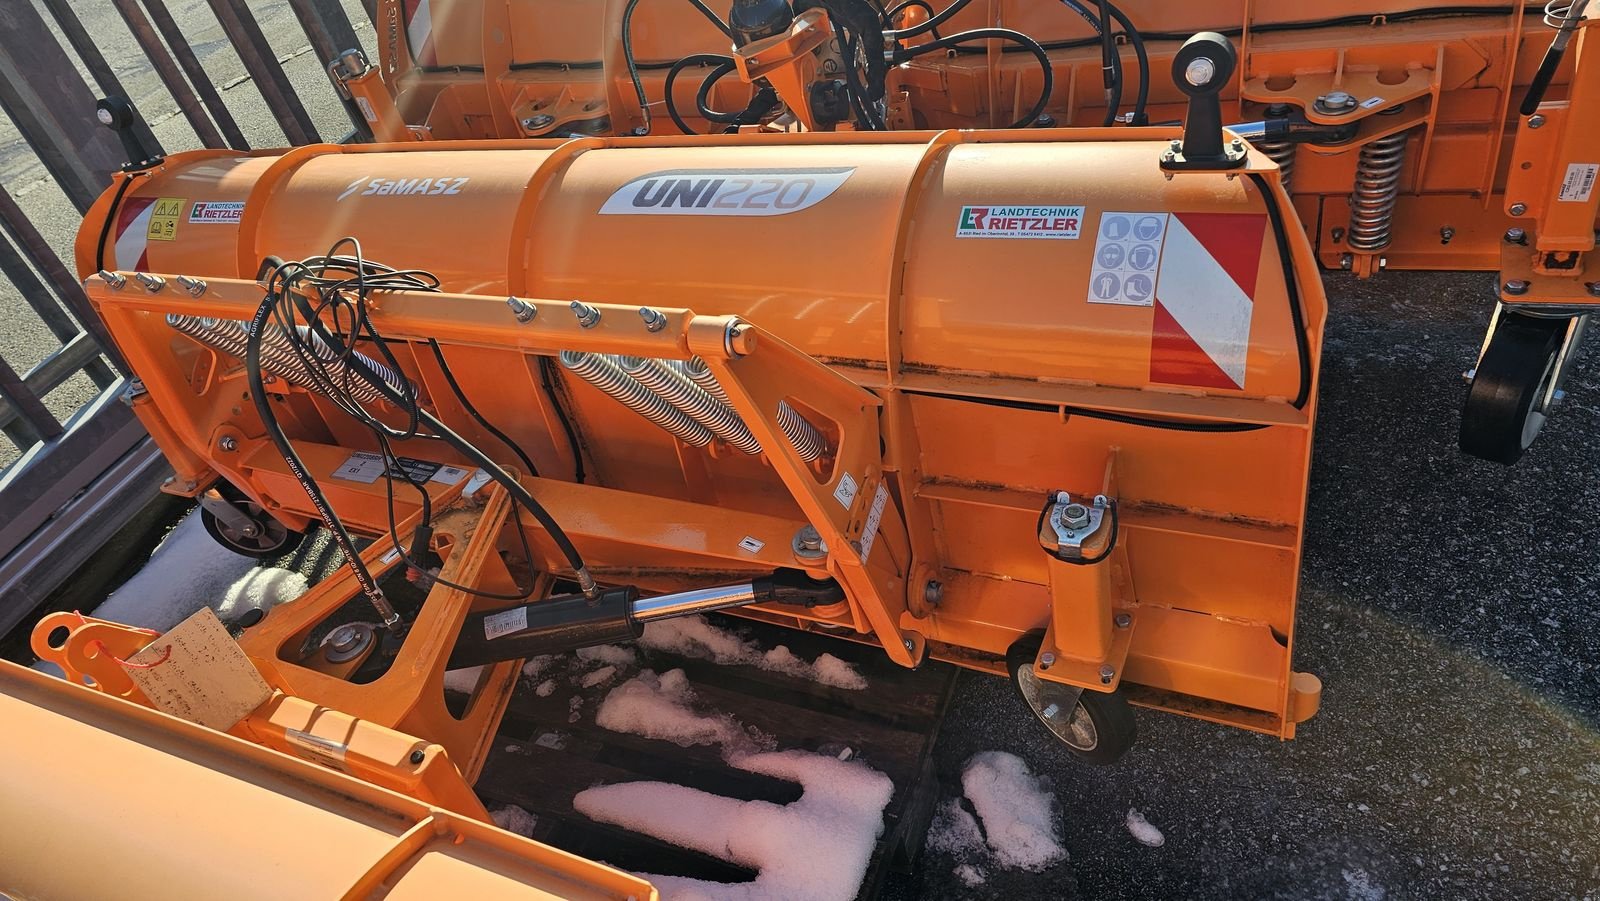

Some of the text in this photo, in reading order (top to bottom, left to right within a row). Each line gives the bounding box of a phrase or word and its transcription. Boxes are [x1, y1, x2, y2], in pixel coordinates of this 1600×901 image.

[361, 177, 471, 196] SaMASZ
[991, 208, 1079, 217] LANDTECHNIK
[988, 217, 1079, 231] RIETZLER
[250, 305, 266, 338] AGRIFLEX
